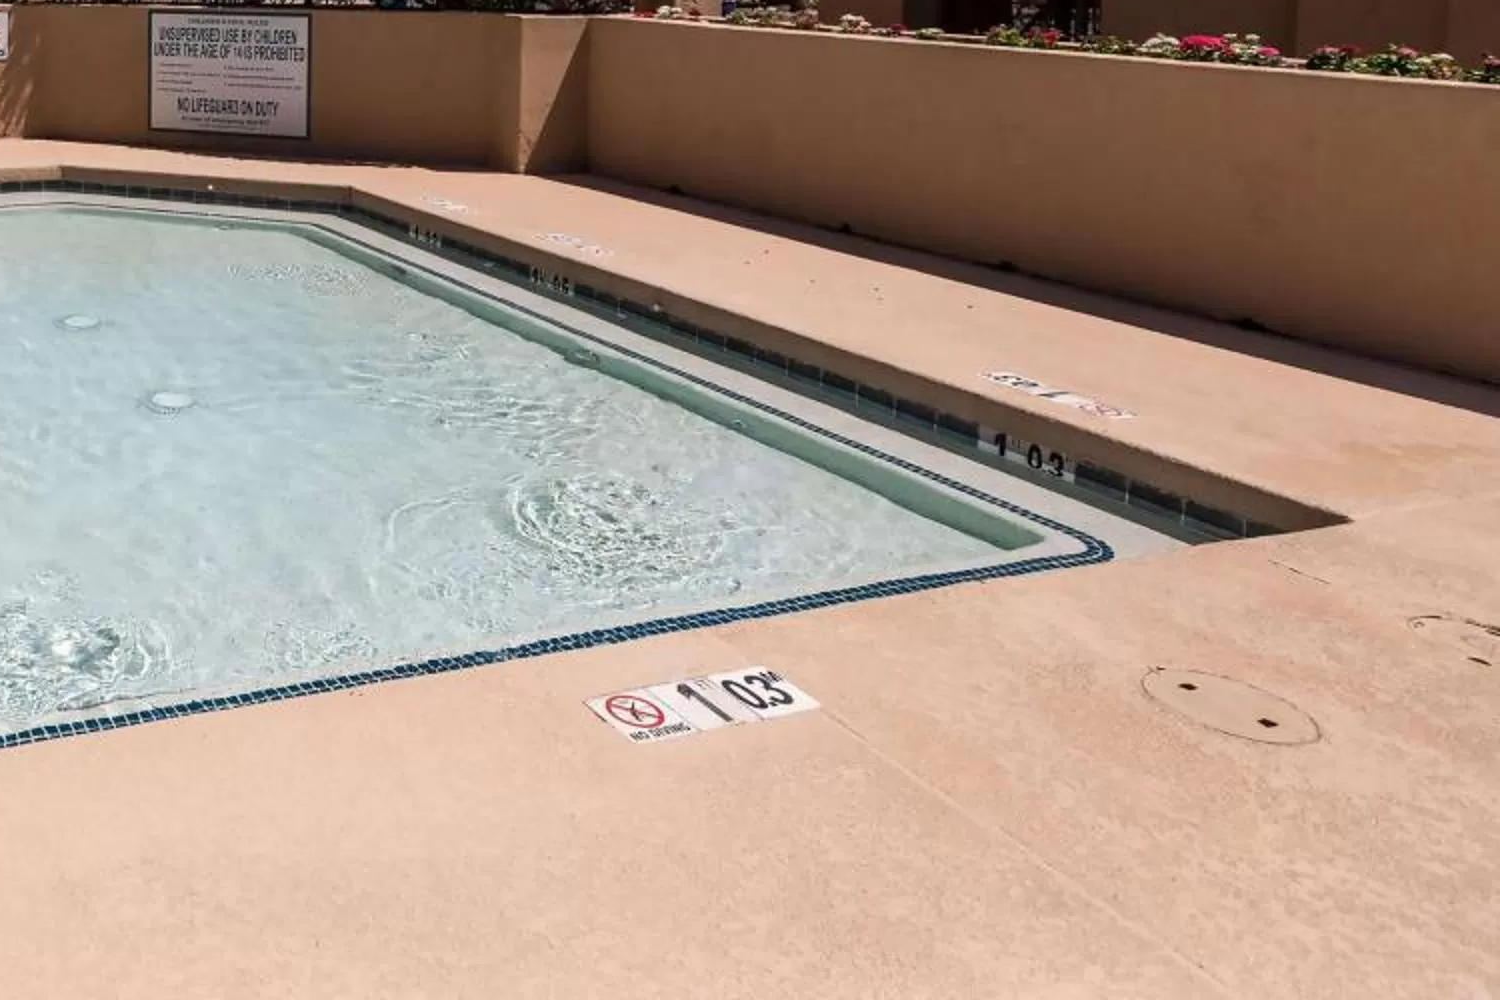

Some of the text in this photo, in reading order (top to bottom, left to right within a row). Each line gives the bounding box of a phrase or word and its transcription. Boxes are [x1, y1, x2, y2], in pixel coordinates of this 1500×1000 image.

[158, 26, 297, 45] UNSUPERVISED USE BY CHILDREN
[153, 42, 181, 56] UNDER
[183, 43, 199, 58] THE
[200, 43, 219, 58] AGE
[220, 43, 231, 59] OF
[253, 46, 305, 62] PROHIBITED
[177, 96, 279, 117] NO LIFEGUARD ON DUTY
[995, 433, 1007, 456] 1
[677, 684, 734, 722] 1
[721, 675, 794, 709] 0.3
